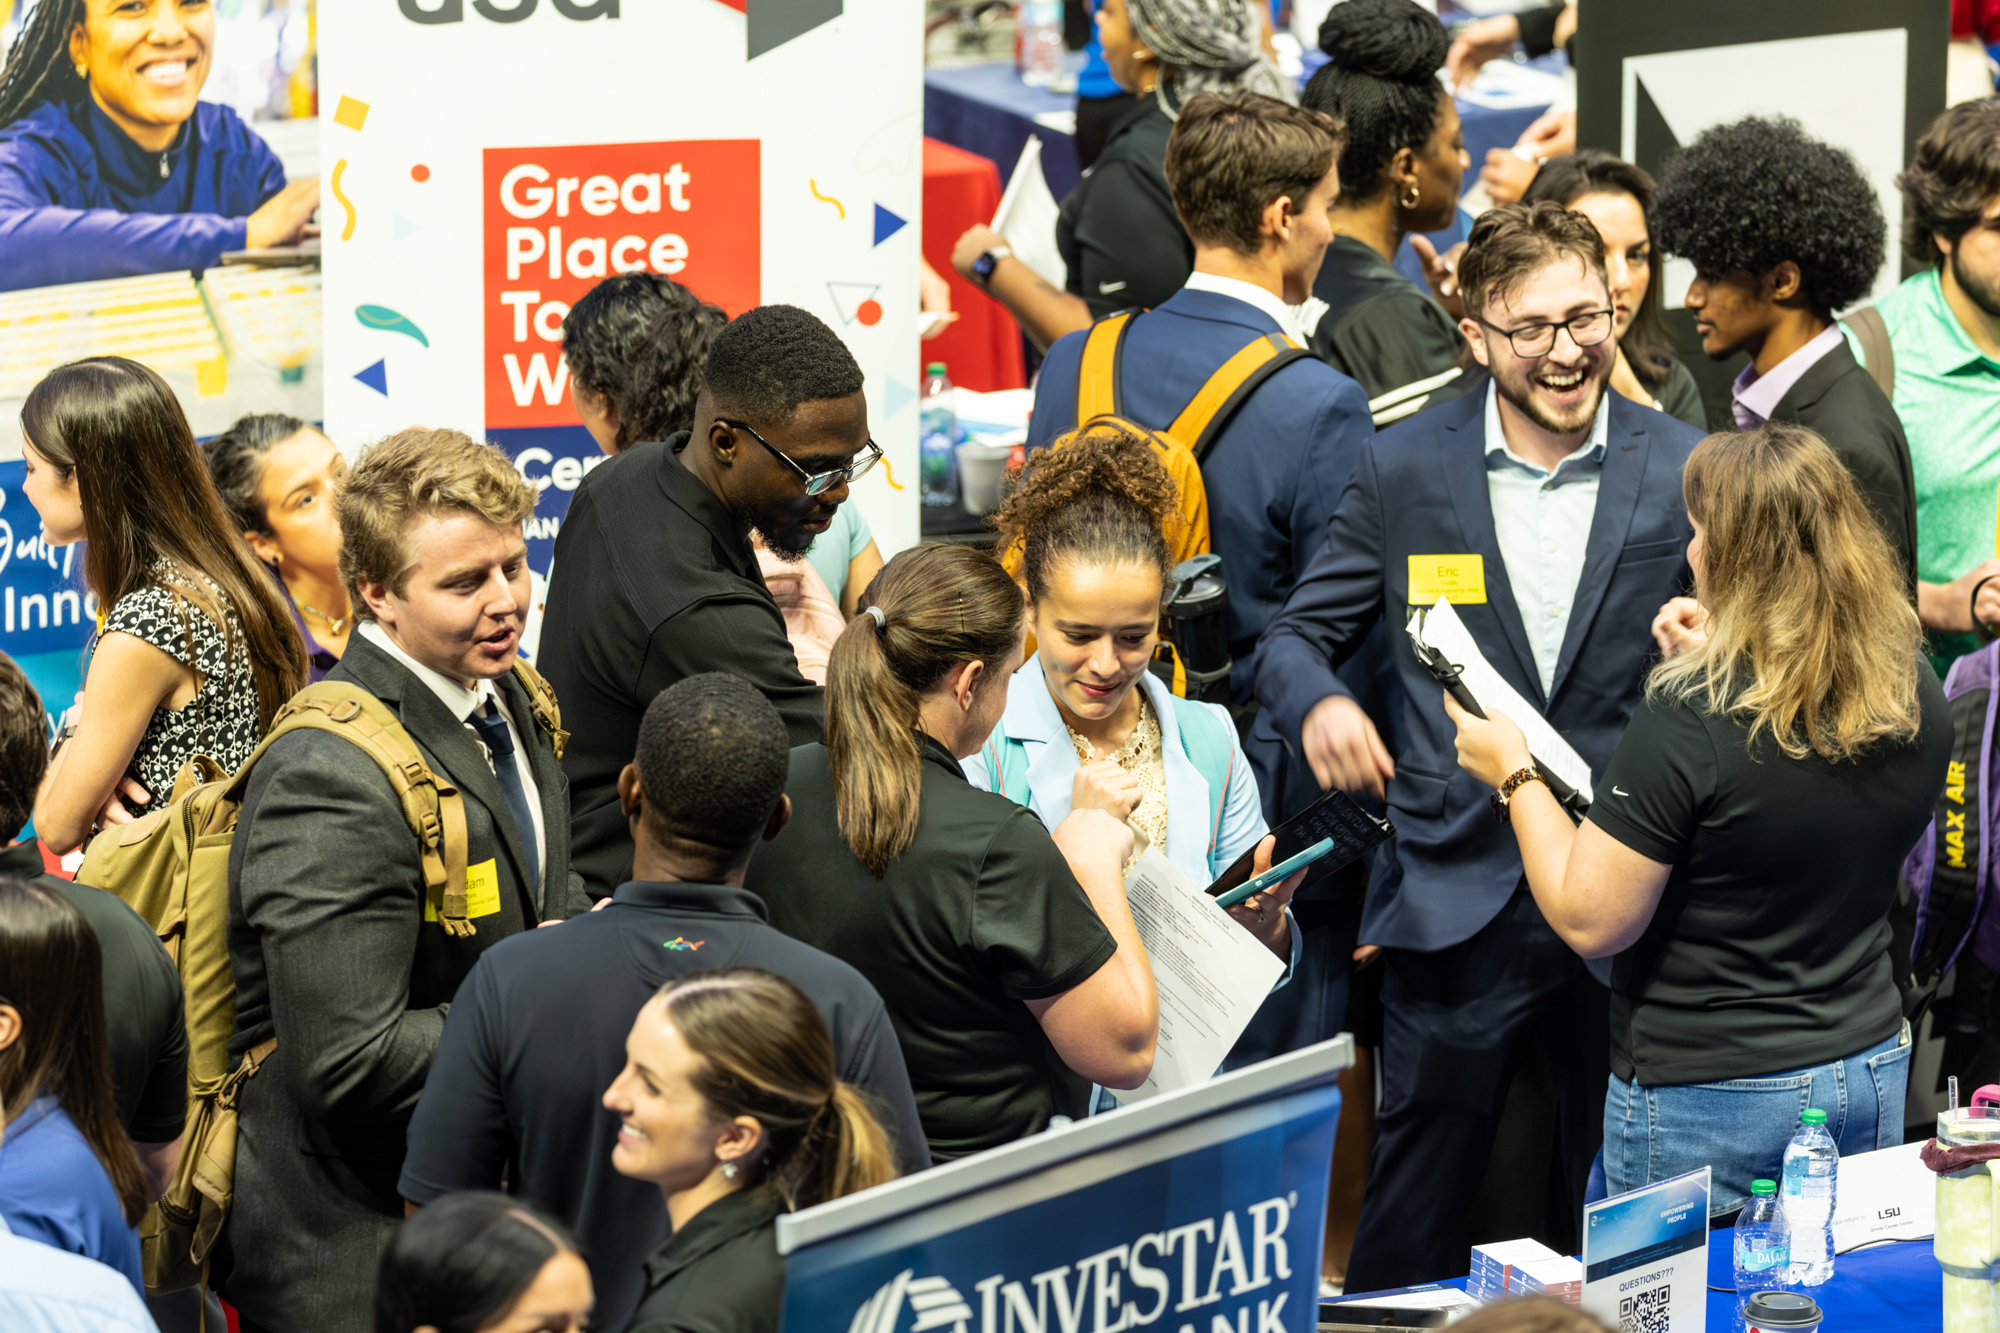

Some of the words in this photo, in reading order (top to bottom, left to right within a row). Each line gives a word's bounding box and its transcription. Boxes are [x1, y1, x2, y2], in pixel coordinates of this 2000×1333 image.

[500, 163, 691, 219] Great
[506, 226, 690, 281] Place
[500, 290, 571, 342] To
[514, 447, 611, 491] Cer
[1437, 566, 1459, 577] Eric
[1946, 760, 1966, 806] AIR
[1945, 809, 1967, 869] MAX
[1660, 1201, 1694, 1219] EMPOWERING
[1666, 1212, 1687, 1225] PEOPLE
[1877, 1207, 1901, 1220] LSU
[1619, 1266, 1675, 1292] QUESTIONS???
